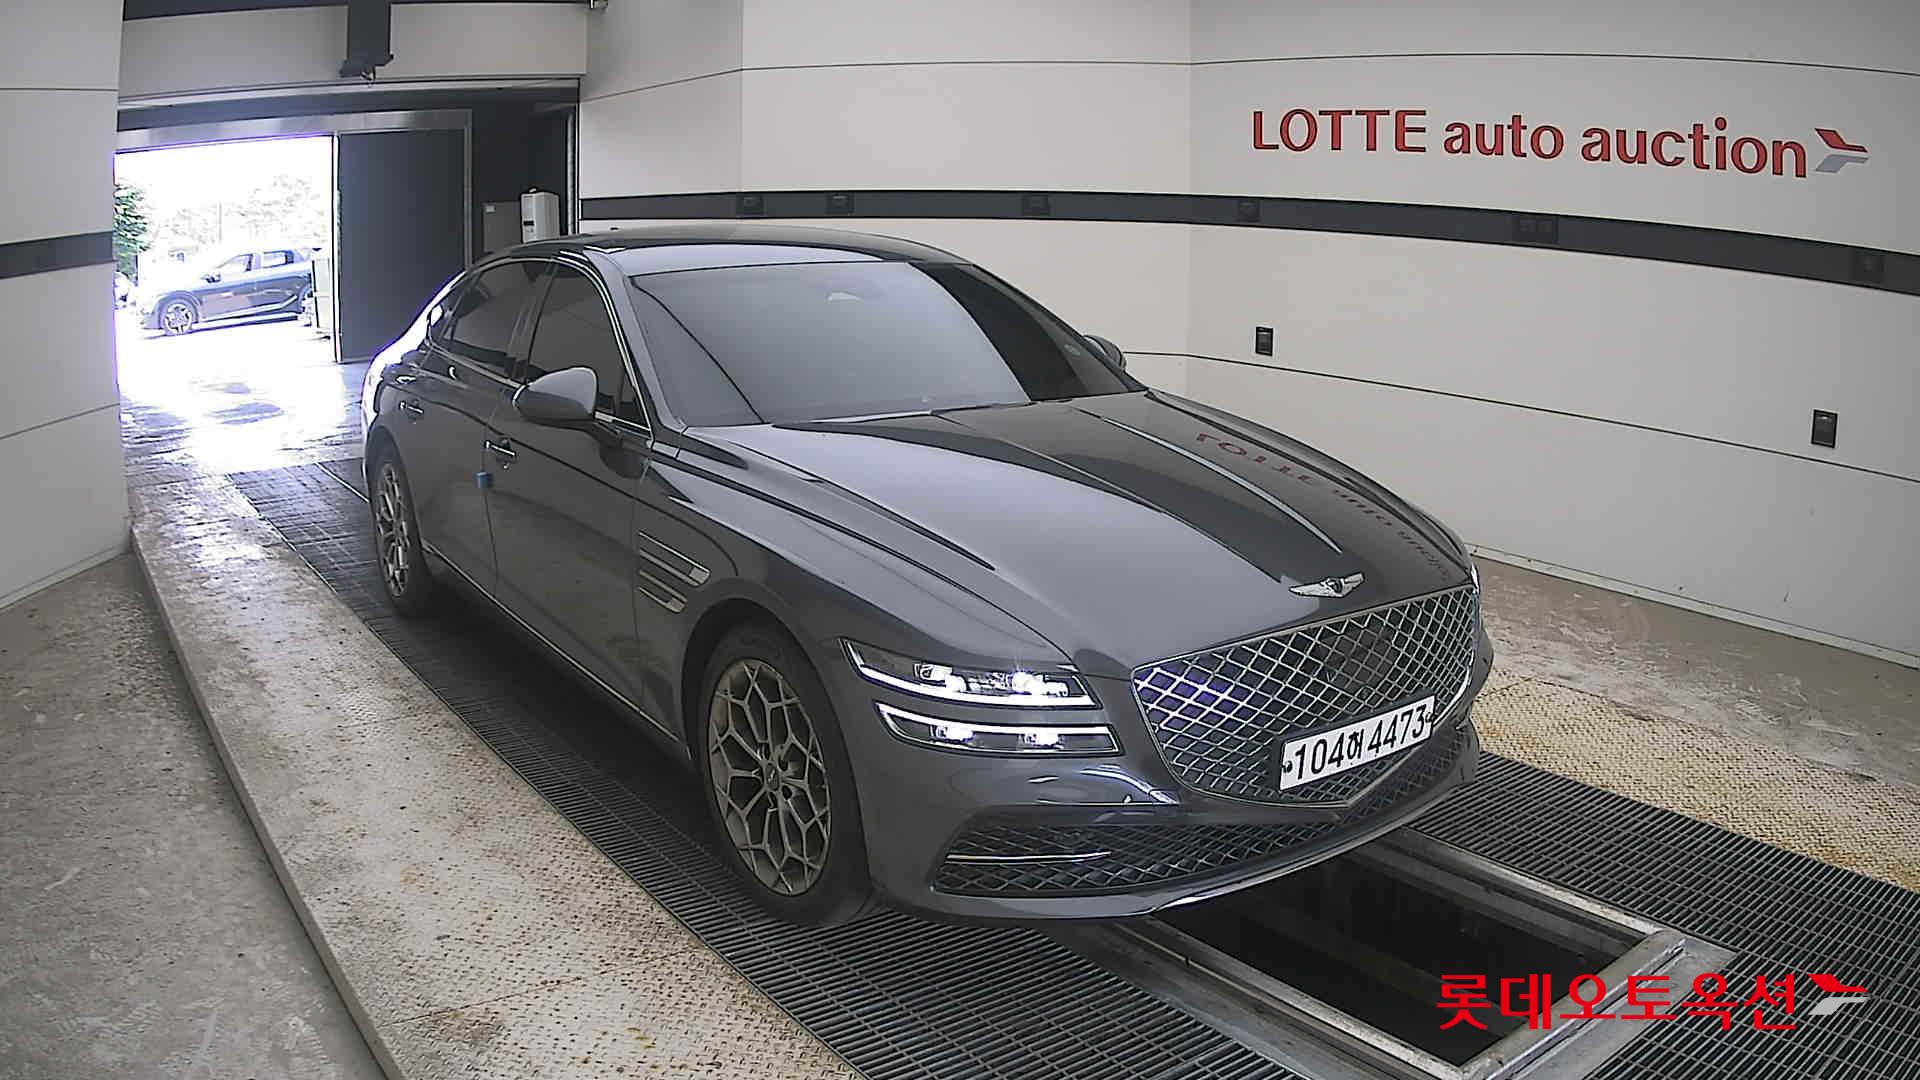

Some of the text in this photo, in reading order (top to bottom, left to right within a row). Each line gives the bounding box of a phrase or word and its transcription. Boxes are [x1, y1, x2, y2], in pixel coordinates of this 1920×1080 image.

[1252, 109, 1808, 179] LOTTE auto auction
